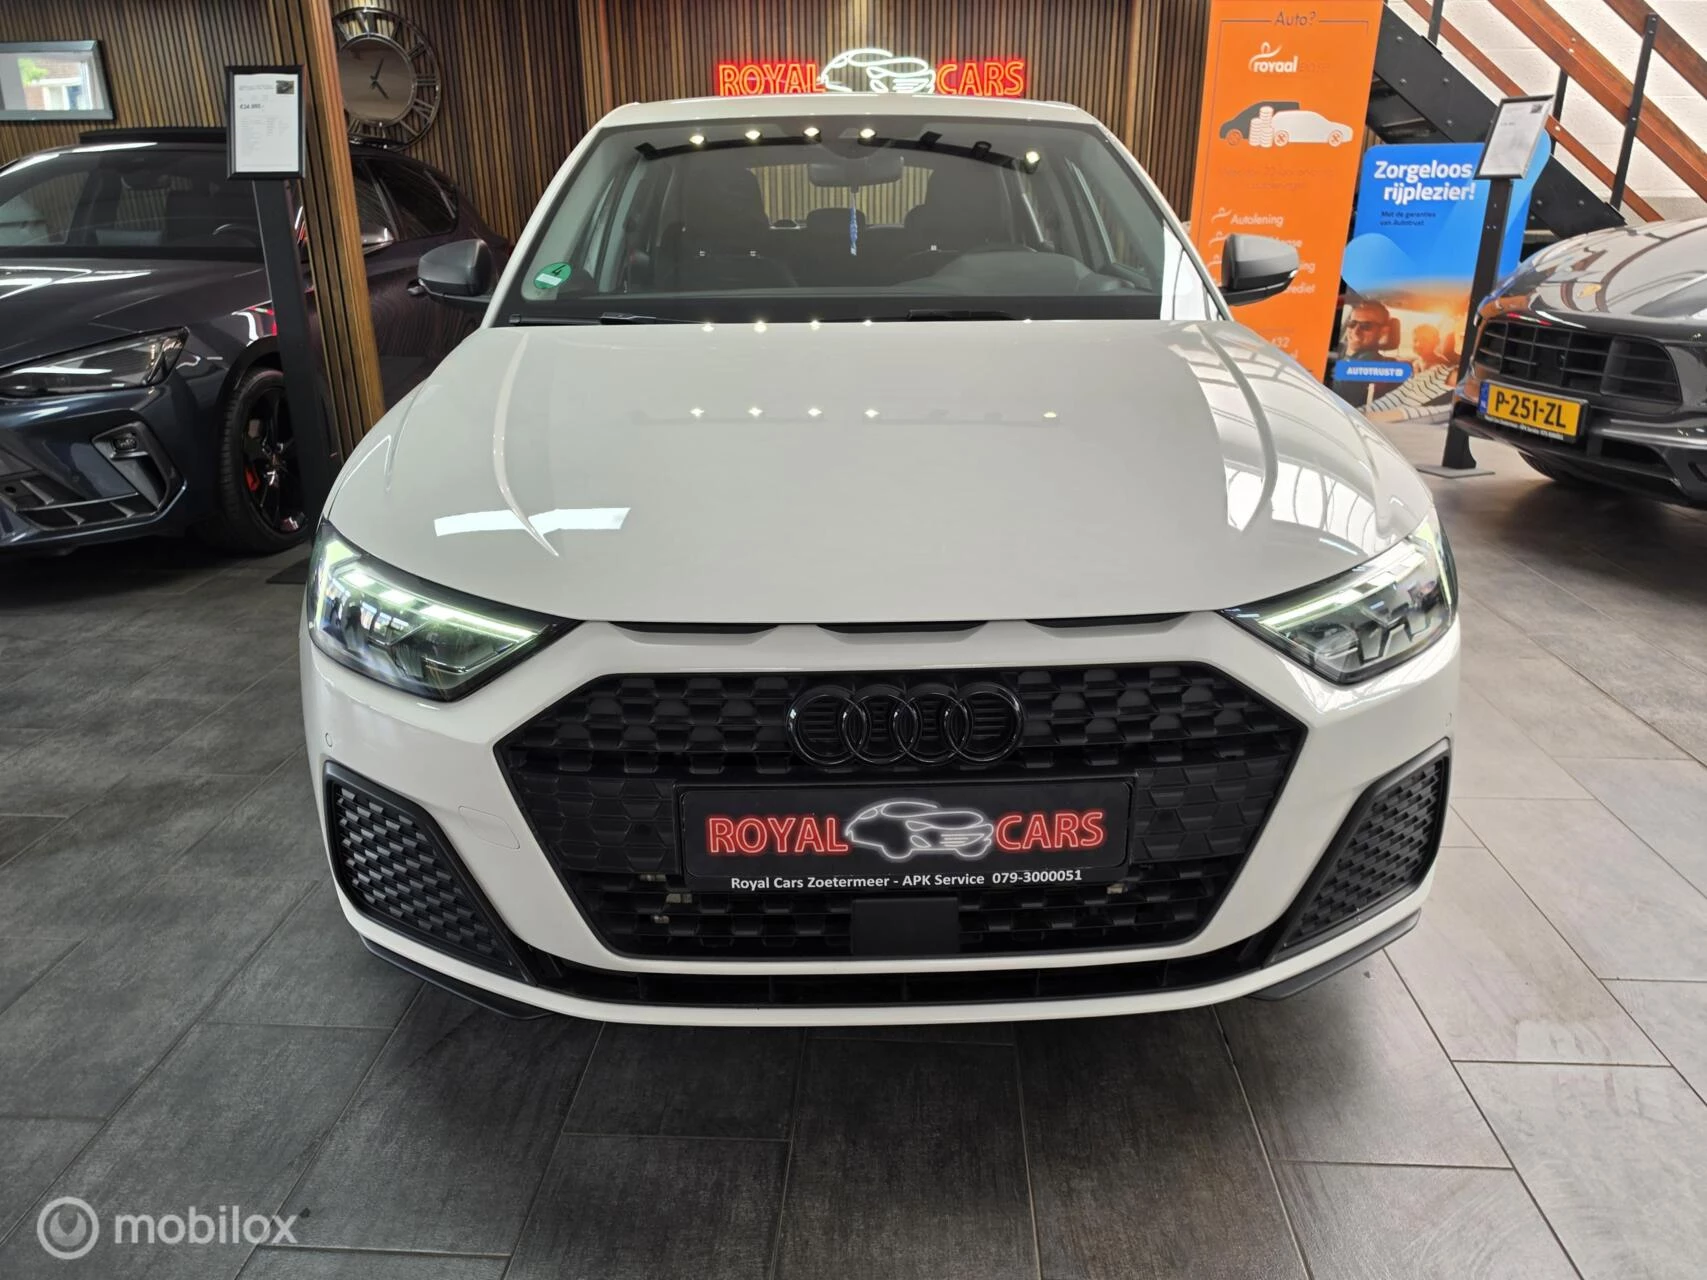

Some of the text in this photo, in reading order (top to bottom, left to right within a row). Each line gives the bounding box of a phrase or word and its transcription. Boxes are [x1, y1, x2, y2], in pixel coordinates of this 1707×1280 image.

[1274, 11, 1316, 26] Auto?
[718, 60, 1026, 97] ROYAL CARS
[1374, 160, 1473, 183] Zorgeloos
[1383, 182, 1476, 205] rijplezier!
[1230, 213, 1284, 227] Autolening
[1346, 366, 1395, 377] AUTOTRUST
[1495, 390, 1566, 429] P-251-ZL
[707, 810, 1106, 854] ROYAL CARS
[731, 877, 770, 890] Royal
[774, 877, 804, 889] Cars
[807, 876, 890, 889] Zoetermeer
[902, 874, 931, 887] APK
[934, 873, 985, 886] Service
[992, 869, 1082, 884] 079-3000051
